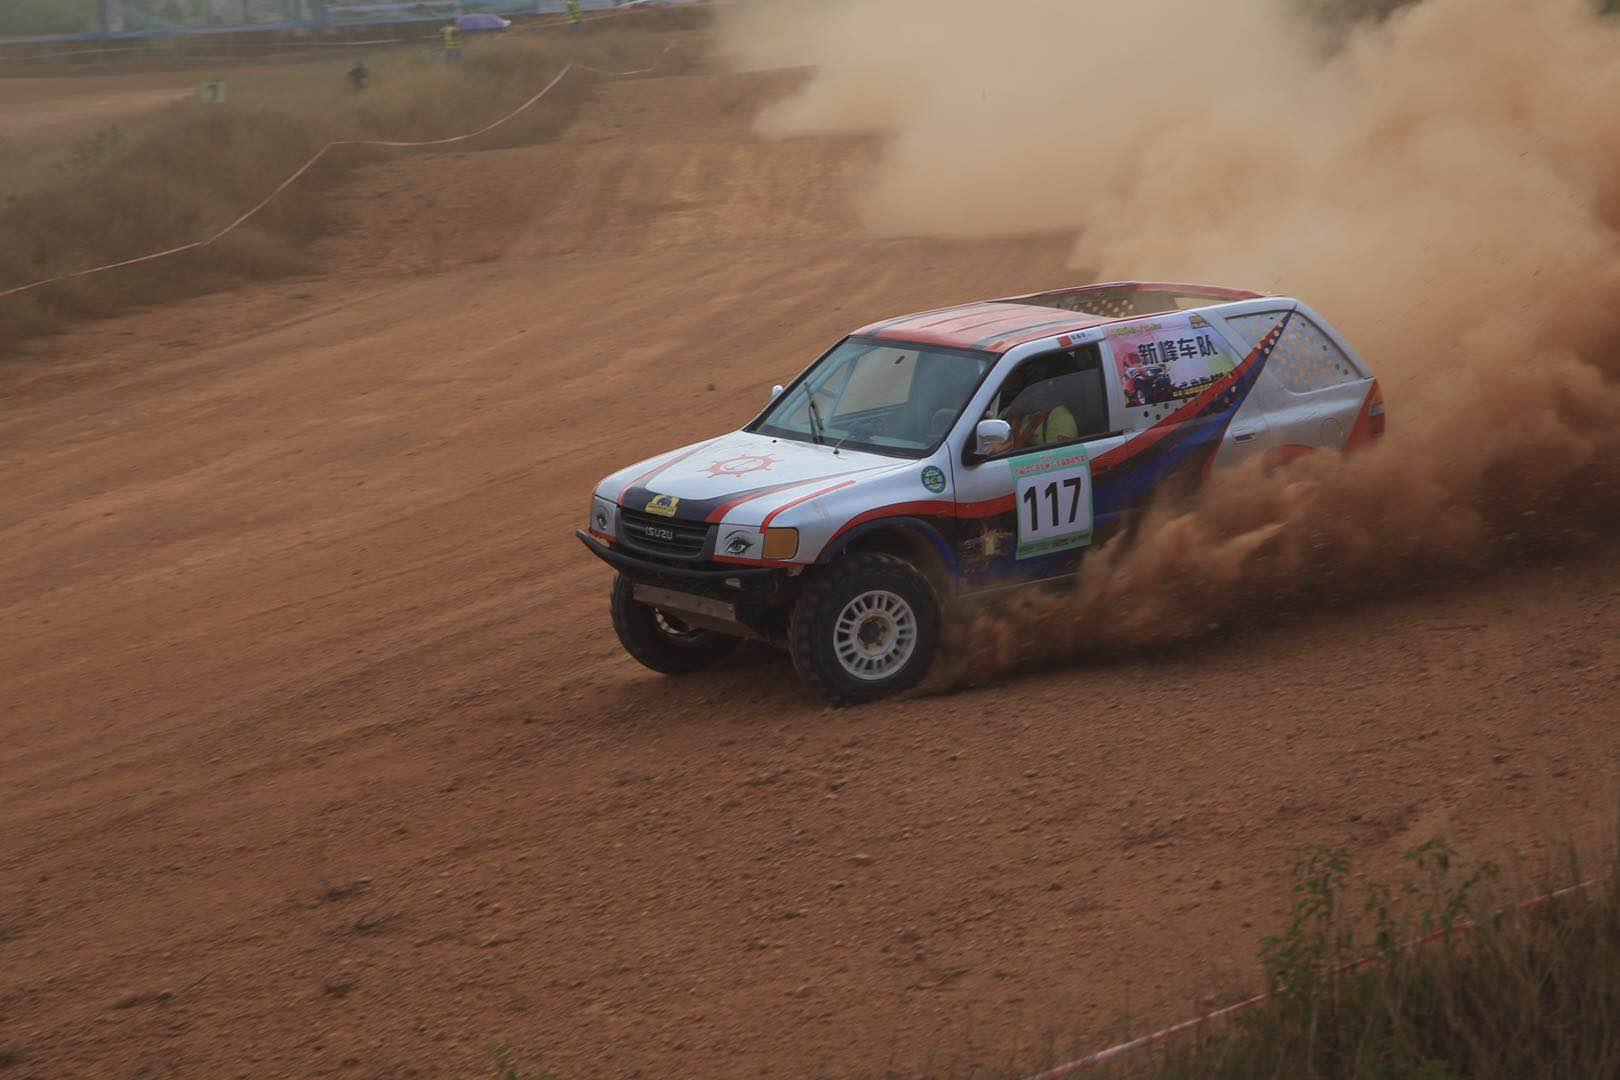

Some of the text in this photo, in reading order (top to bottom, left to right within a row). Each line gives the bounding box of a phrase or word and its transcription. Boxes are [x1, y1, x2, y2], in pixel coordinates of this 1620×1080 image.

[1138, 334, 1218, 366] 新峰车队
[1023, 476, 1082, 532] 117
[645, 526, 674, 541] ISUZU
